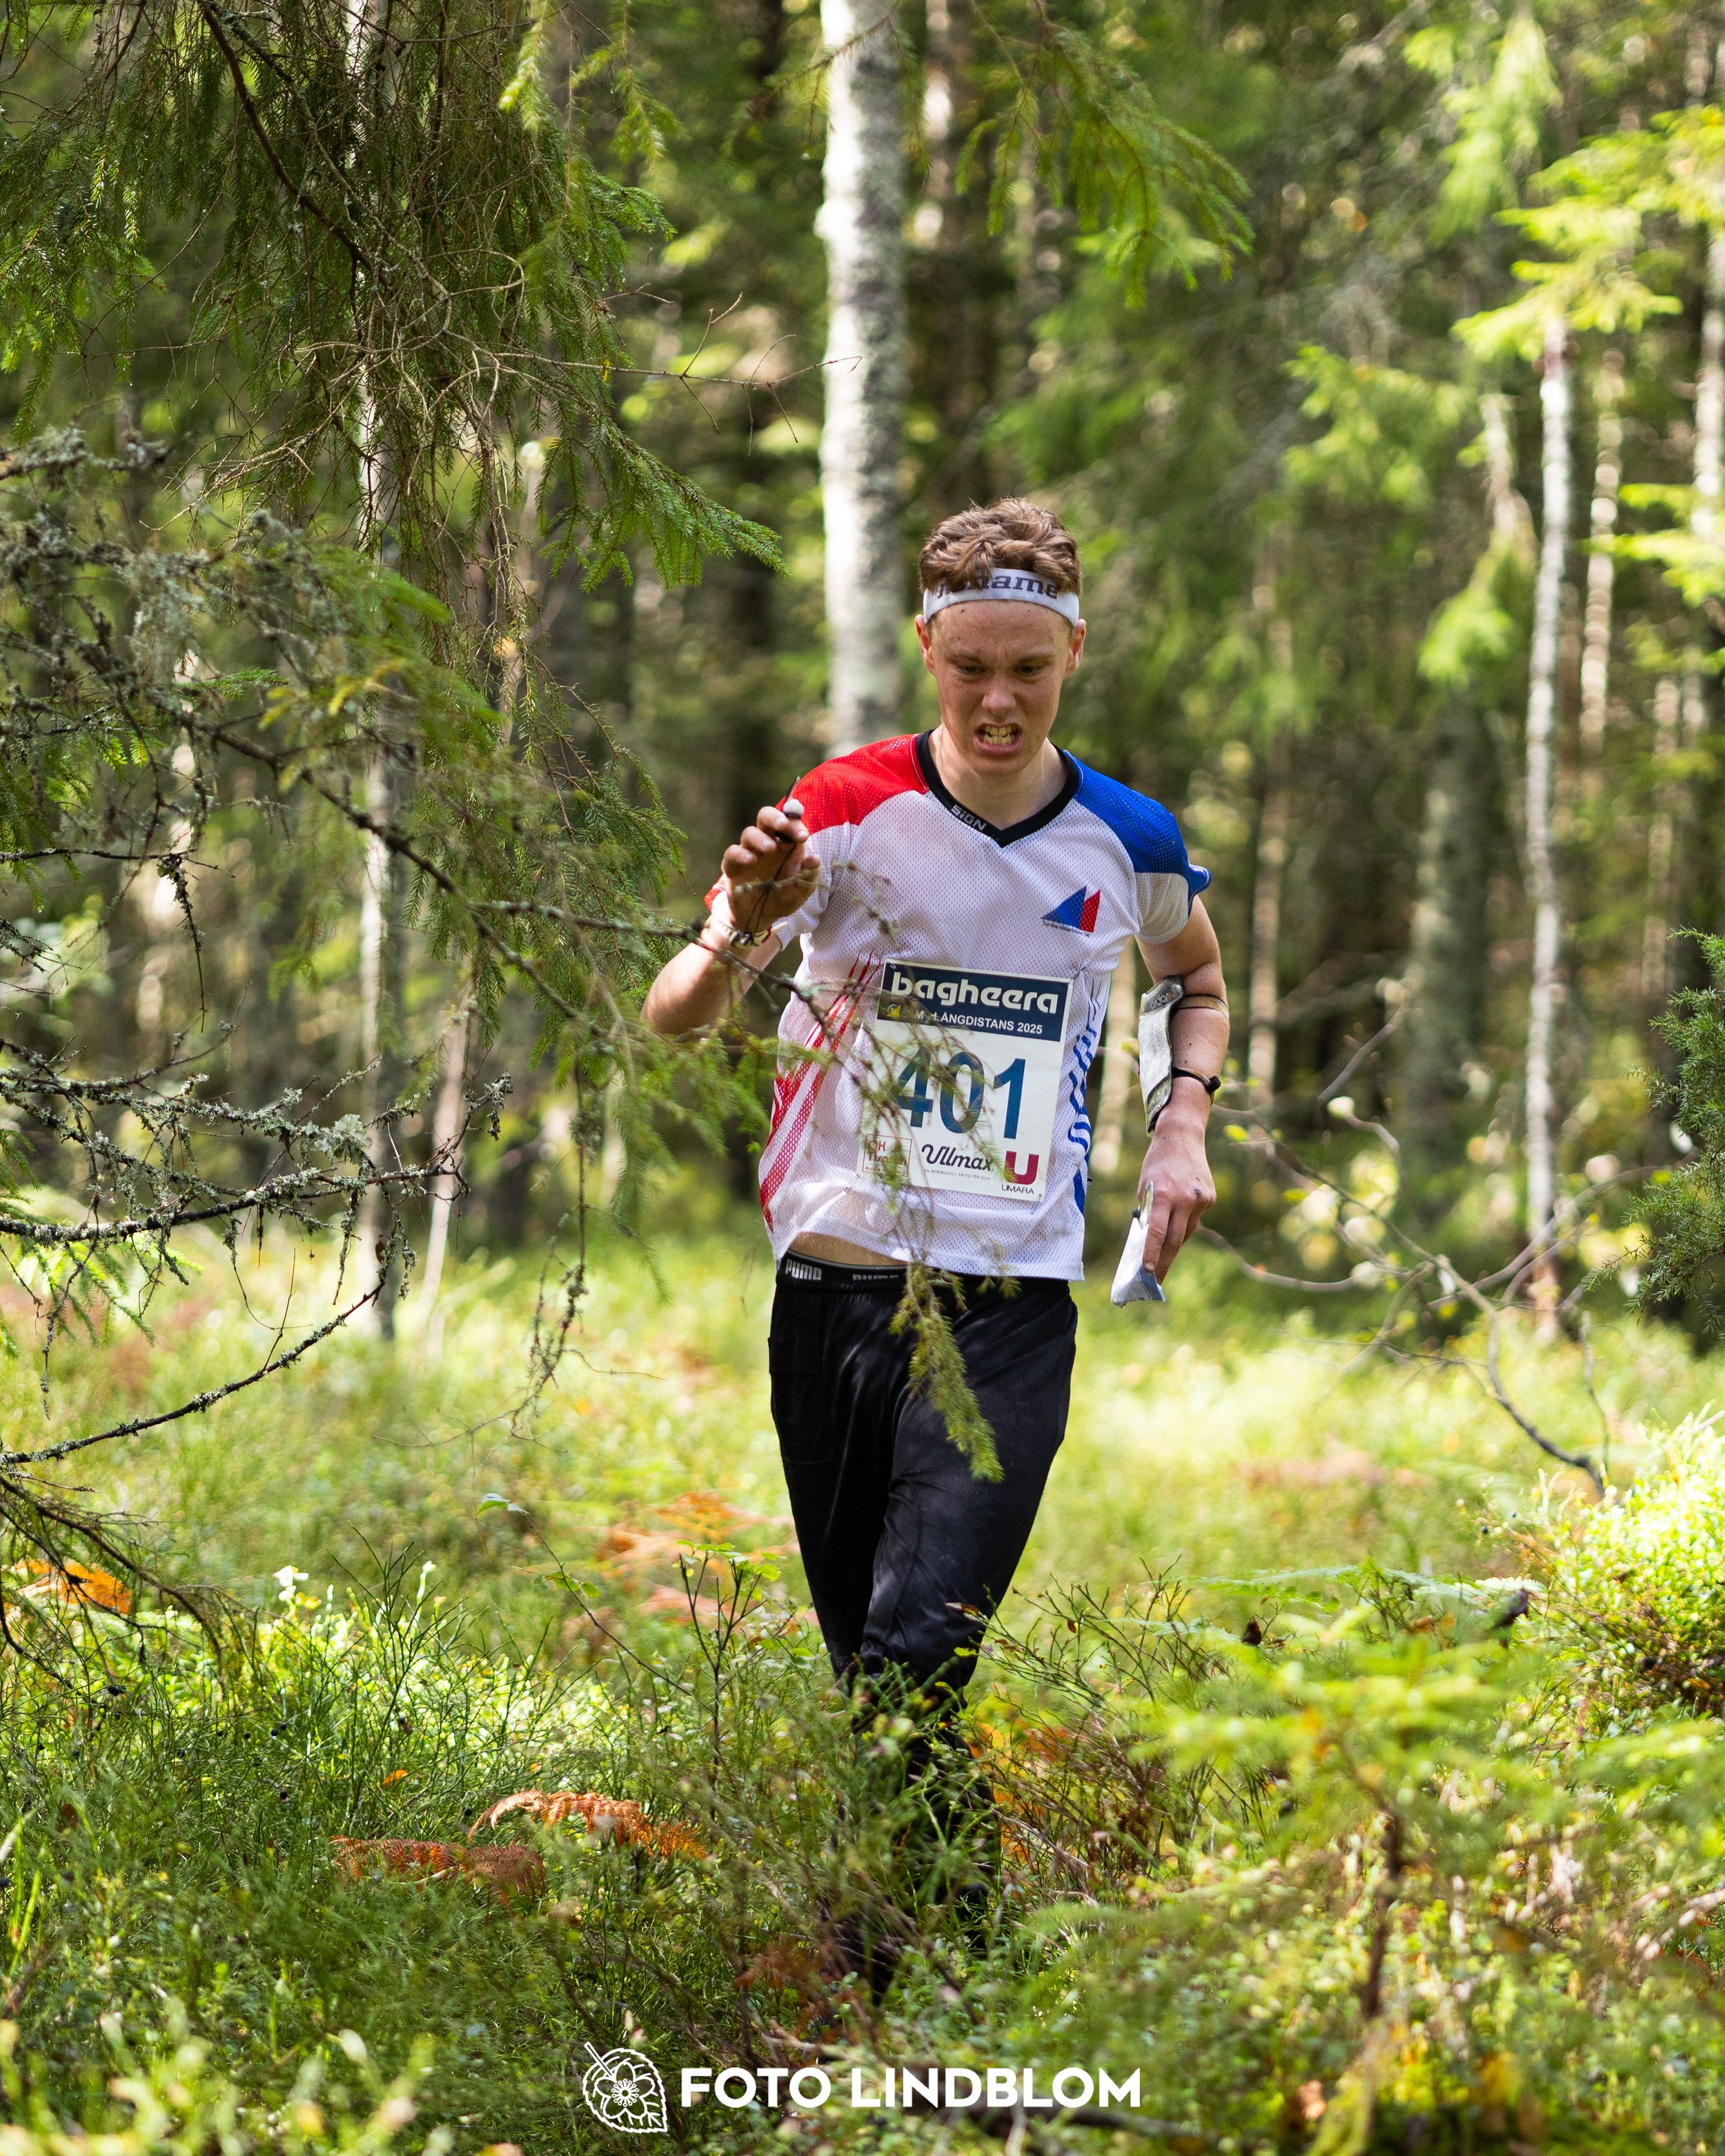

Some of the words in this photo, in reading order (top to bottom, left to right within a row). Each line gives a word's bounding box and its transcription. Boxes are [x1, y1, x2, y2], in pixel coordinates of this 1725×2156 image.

[891, 971, 1058, 1014] bagheera
[934, 1011, 1014, 1031] LÅNGDISTANS
[1017, 1022, 1043, 1034] 2025
[887, 1045, 1026, 1140] 401
[921, 1143, 994, 1171] Ullmax
[1001, 1184, 1035, 1195] UMARA
